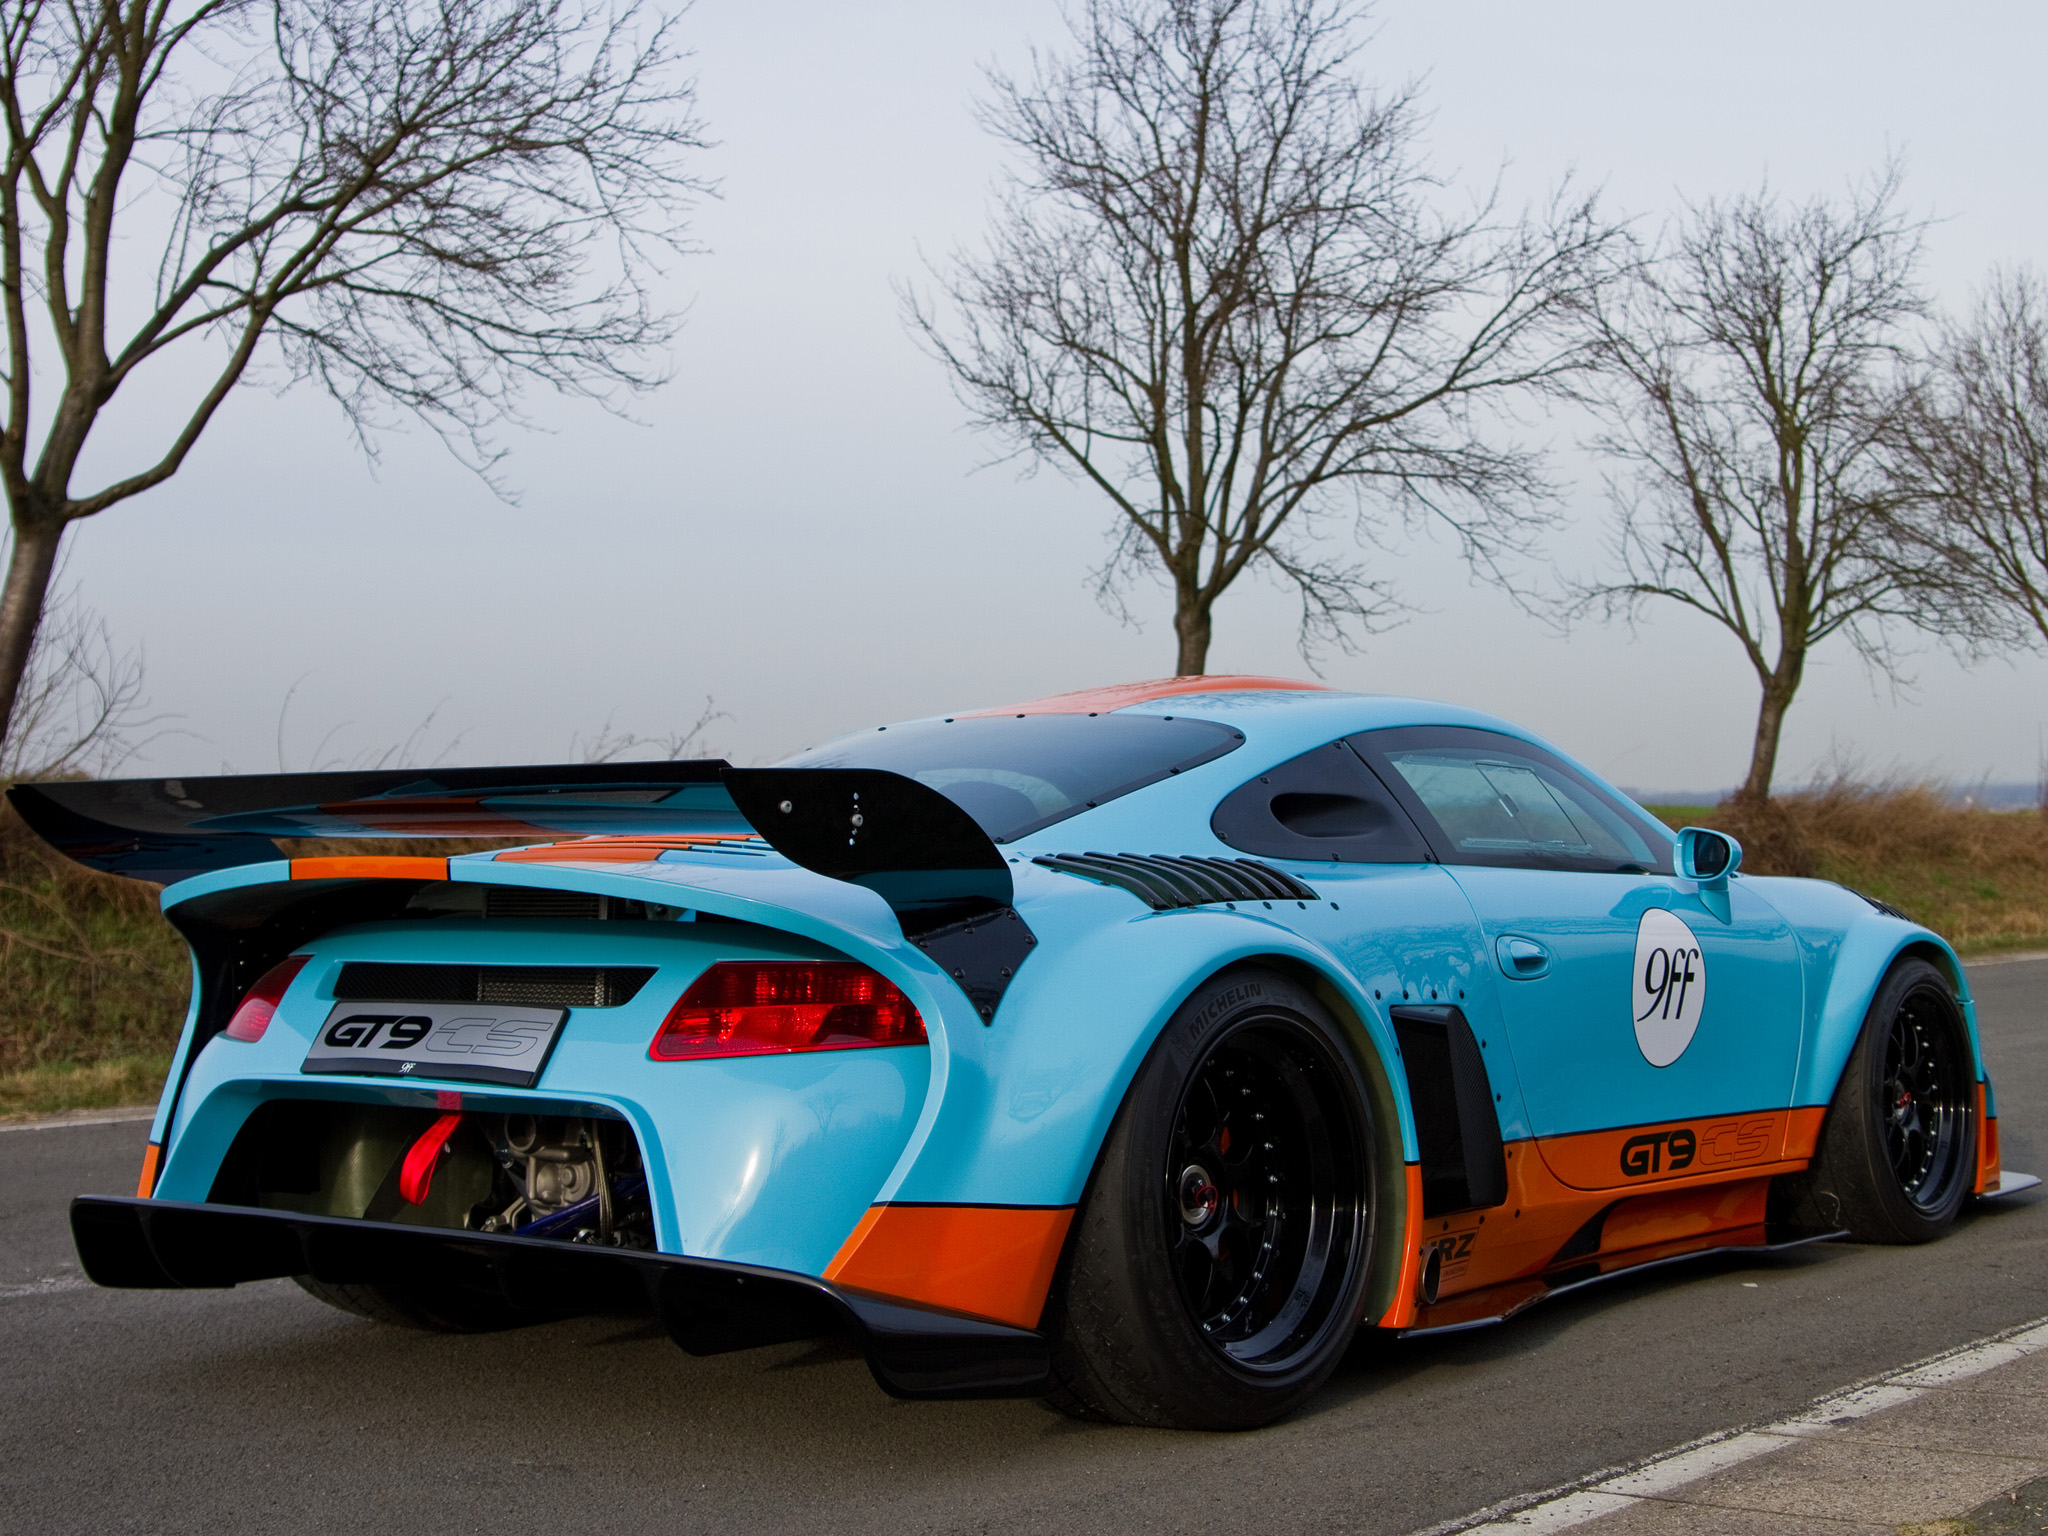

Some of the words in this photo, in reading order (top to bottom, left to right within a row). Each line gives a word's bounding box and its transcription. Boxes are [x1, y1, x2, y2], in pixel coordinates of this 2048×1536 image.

[1188, 983, 1262, 1040] MICHELIN
[1637, 947, 1699, 1022] 9ff
[324, 1014, 433, 1049] GT9
[425, 1017, 554, 1057] CS
[1620, 1128, 1697, 1177] GT9
[1700, 1118, 1775, 1165] CS
